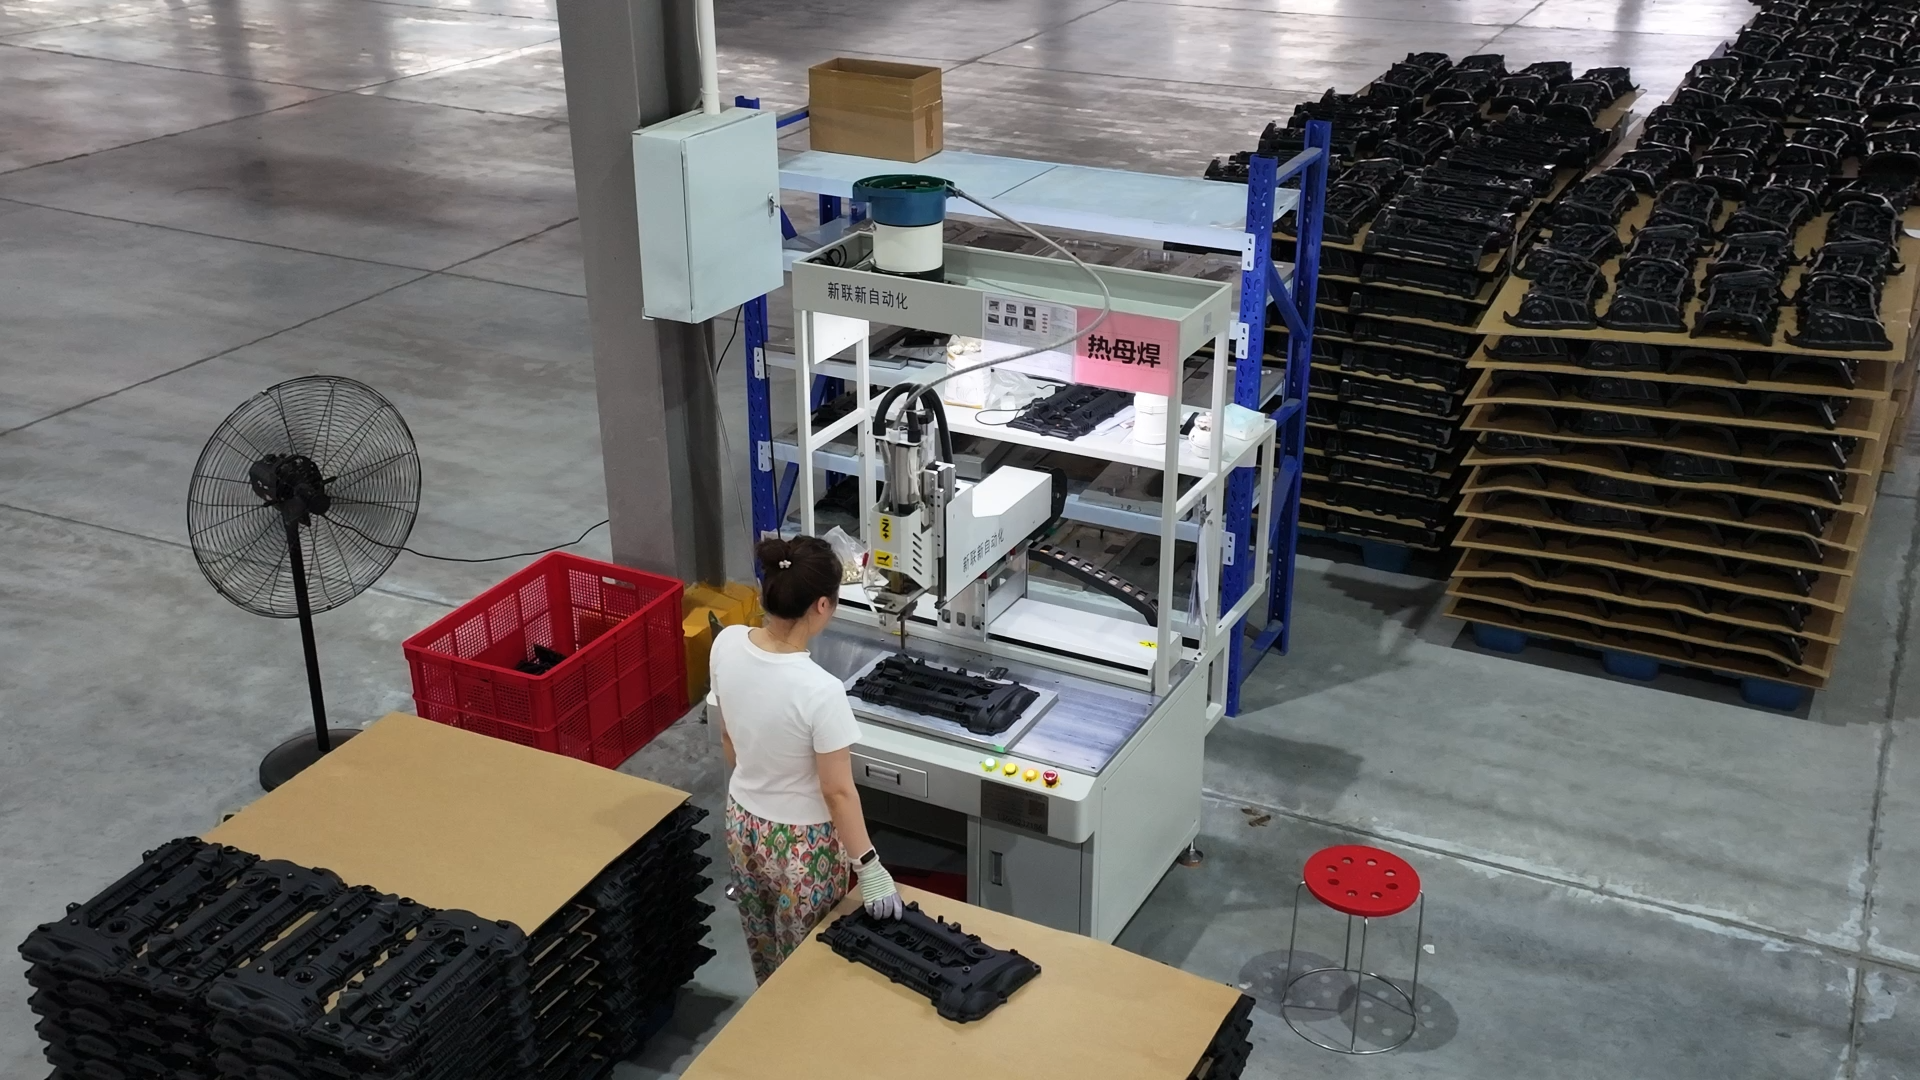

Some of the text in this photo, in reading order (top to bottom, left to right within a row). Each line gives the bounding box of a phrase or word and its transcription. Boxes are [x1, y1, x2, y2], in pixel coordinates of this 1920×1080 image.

[828, 282, 908, 310] 新联新自动化
[1088, 334, 1161, 368] 热母焊
[963, 528, 1004, 573] 新联新自动化
